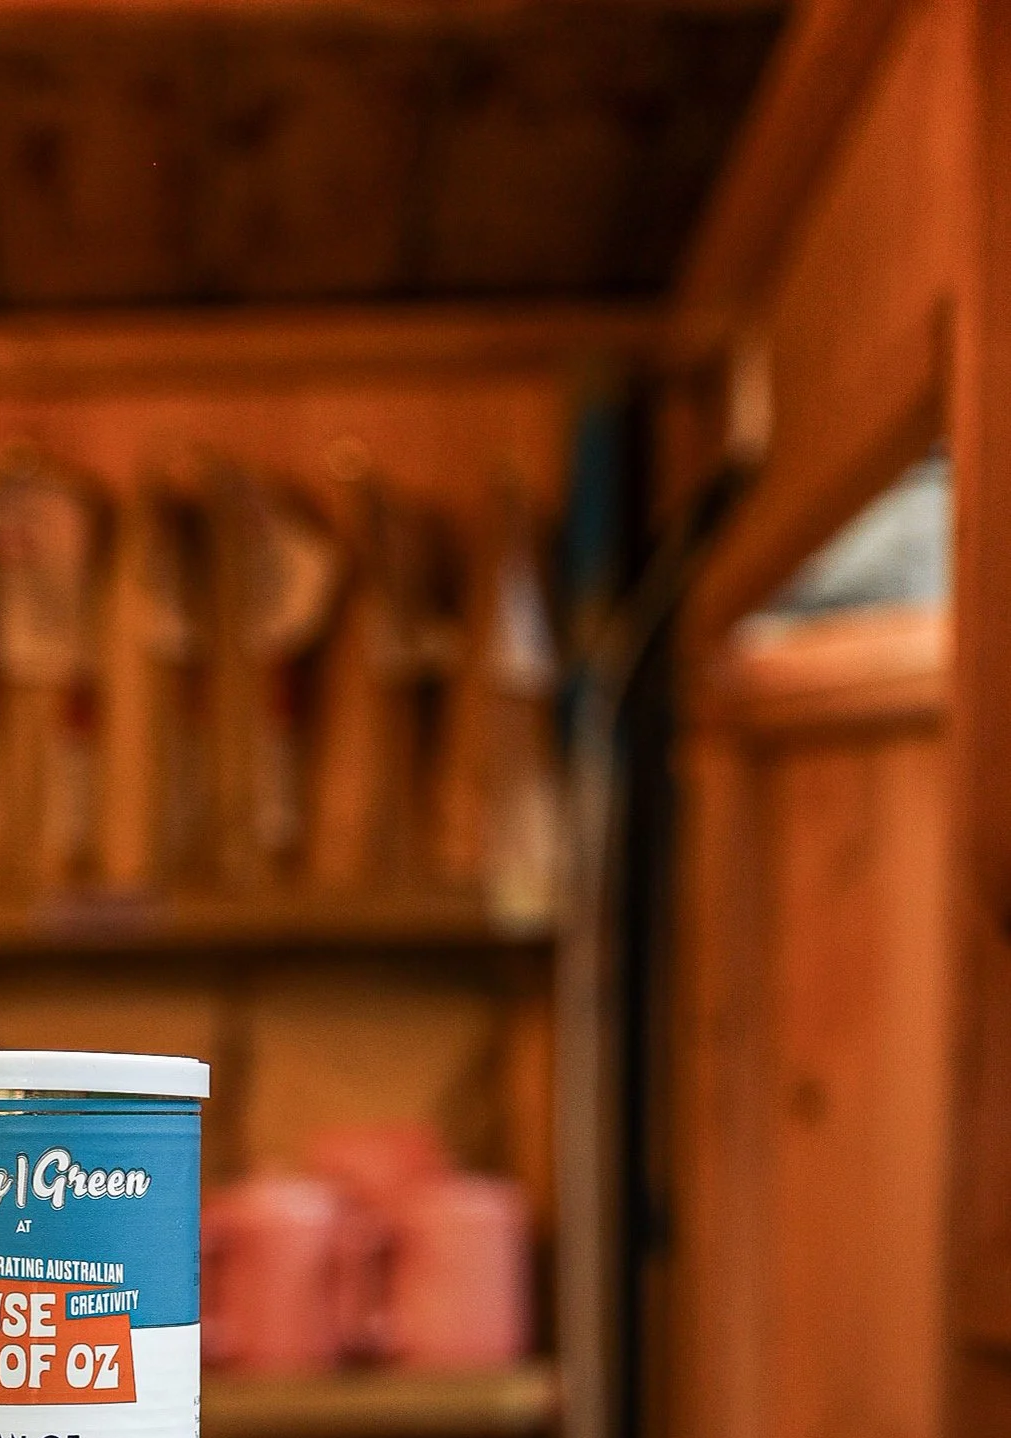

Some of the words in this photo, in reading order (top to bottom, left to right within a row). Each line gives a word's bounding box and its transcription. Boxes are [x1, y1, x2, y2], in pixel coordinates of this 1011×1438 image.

[16, 1220, 32, 1232] AT
[46, 1260, 123, 1283] AUSTRALIAN
[71, 1290, 138, 1315] CREATIVITY
[67, 1344, 119, 1389] OZ
